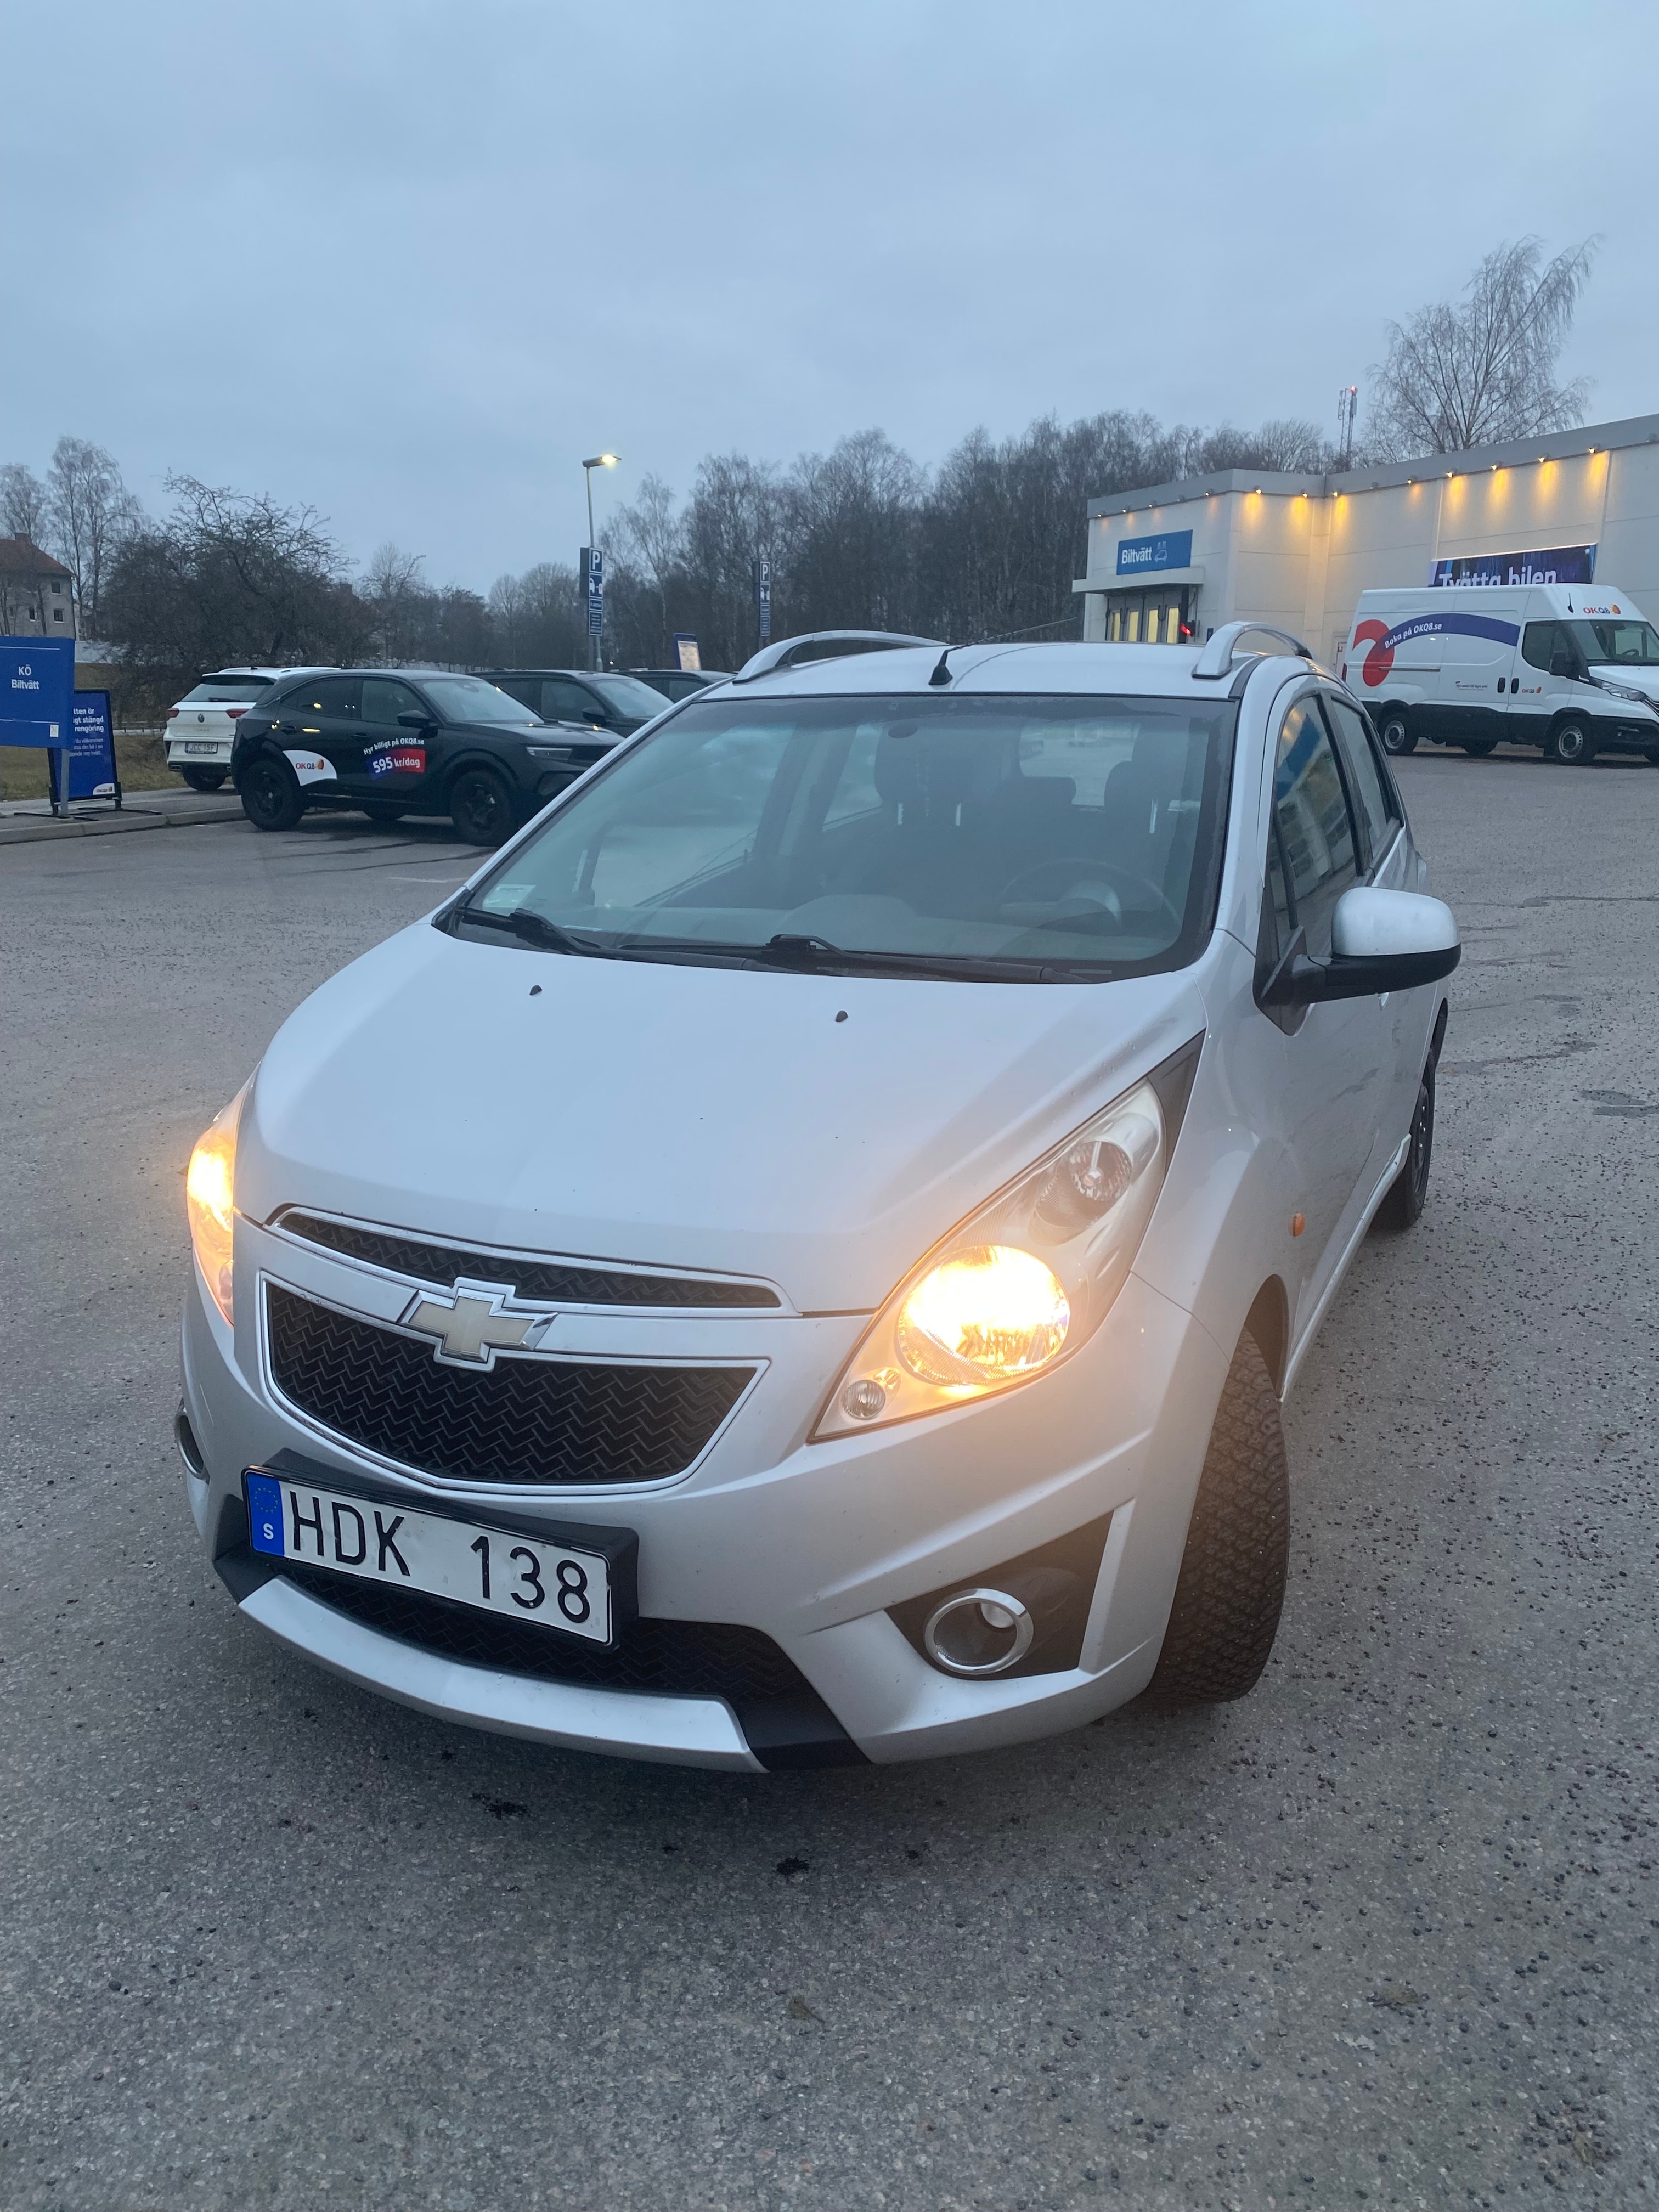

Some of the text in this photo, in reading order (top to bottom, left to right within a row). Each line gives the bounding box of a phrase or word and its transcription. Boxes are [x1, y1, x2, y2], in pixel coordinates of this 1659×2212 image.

[592, 551, 601, 570] P
[1121, 546, 1152, 564] Biltvätt
[762, 564, 768, 580] P
[1509, 565, 1557, 585] bilen
[1385, 622, 1442, 648] Boka på OKQ8.se
[18, 664, 32, 676] KÖ
[12, 679, 40, 690] Biltvätt
[82, 715, 104, 724] stängd
[75, 725, 104, 733] rengöring
[363, 746, 374, 755] Hyr
[374, 741, 391, 750] billigt
[392, 738, 399, 747] på
[373, 757, 420, 774] 595 kr/dag
[262, 1491, 591, 1623] S HDK 138
